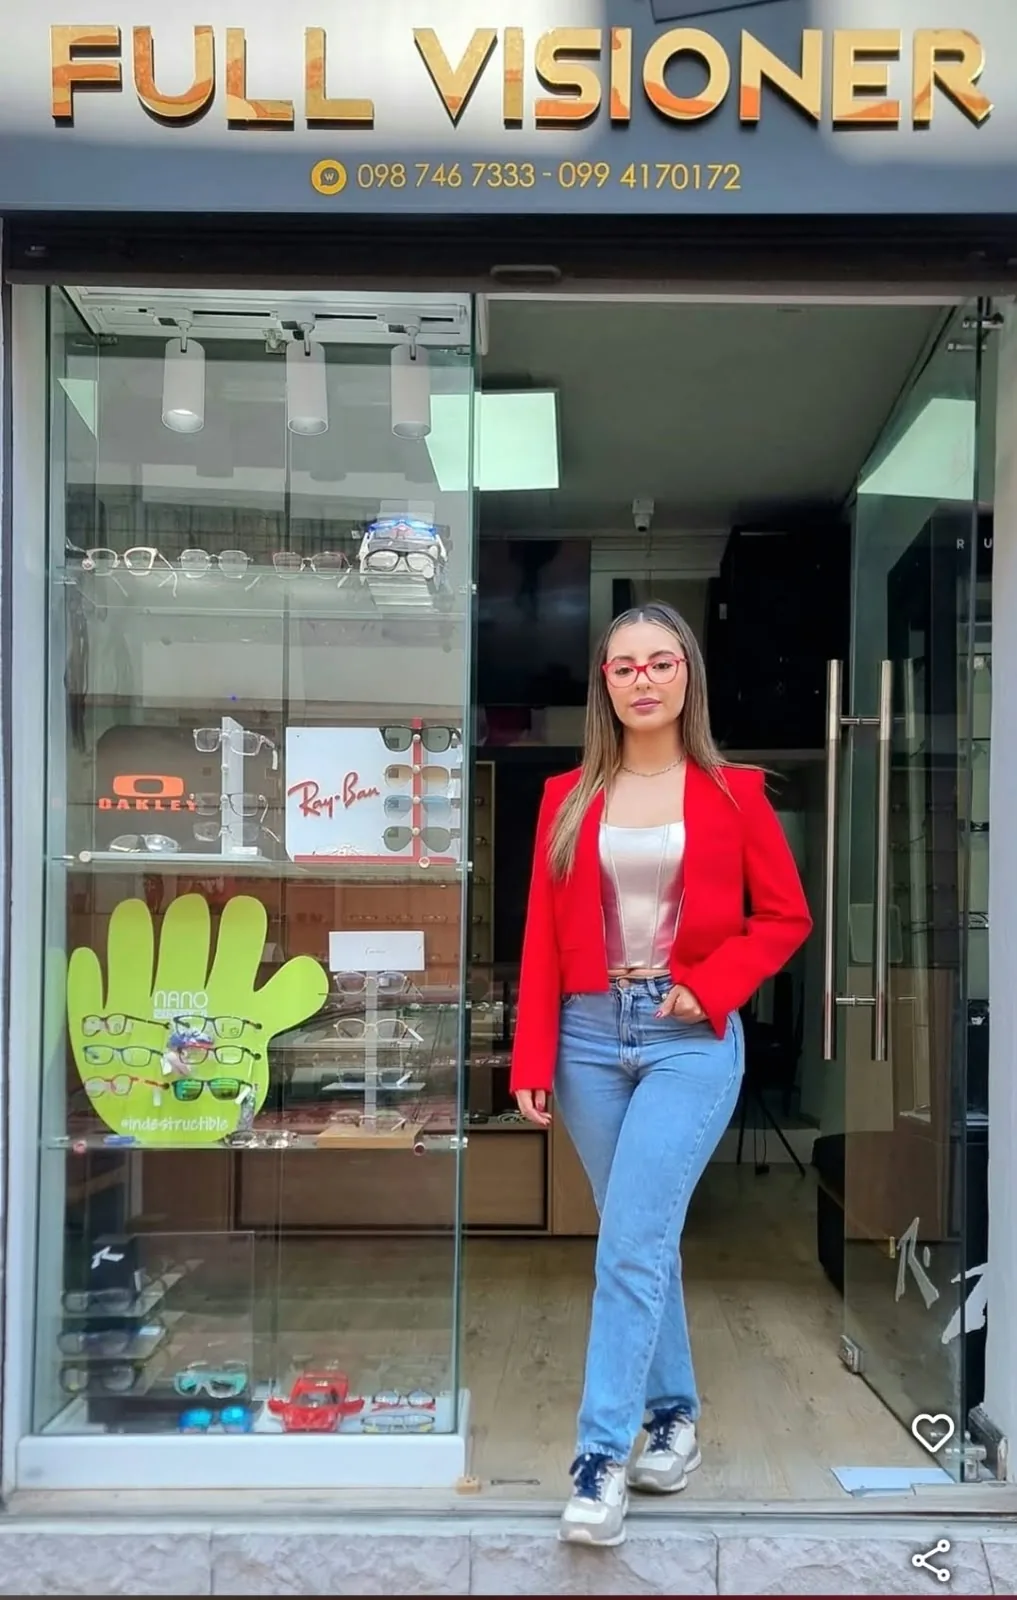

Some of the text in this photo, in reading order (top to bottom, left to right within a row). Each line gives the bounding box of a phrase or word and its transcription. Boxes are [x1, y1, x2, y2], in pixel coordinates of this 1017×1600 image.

[49, 24, 995, 130] FULL VISIONER
[357, 162, 406, 188] 098
[414, 162, 463, 188] 746
[471, 162, 536, 188] 7333
[558, 161, 611, 188] 099
[619, 162, 742, 190] 4170172
[98, 797, 197, 811] OAKLEY
[154, 990, 209, 1009] NANO
